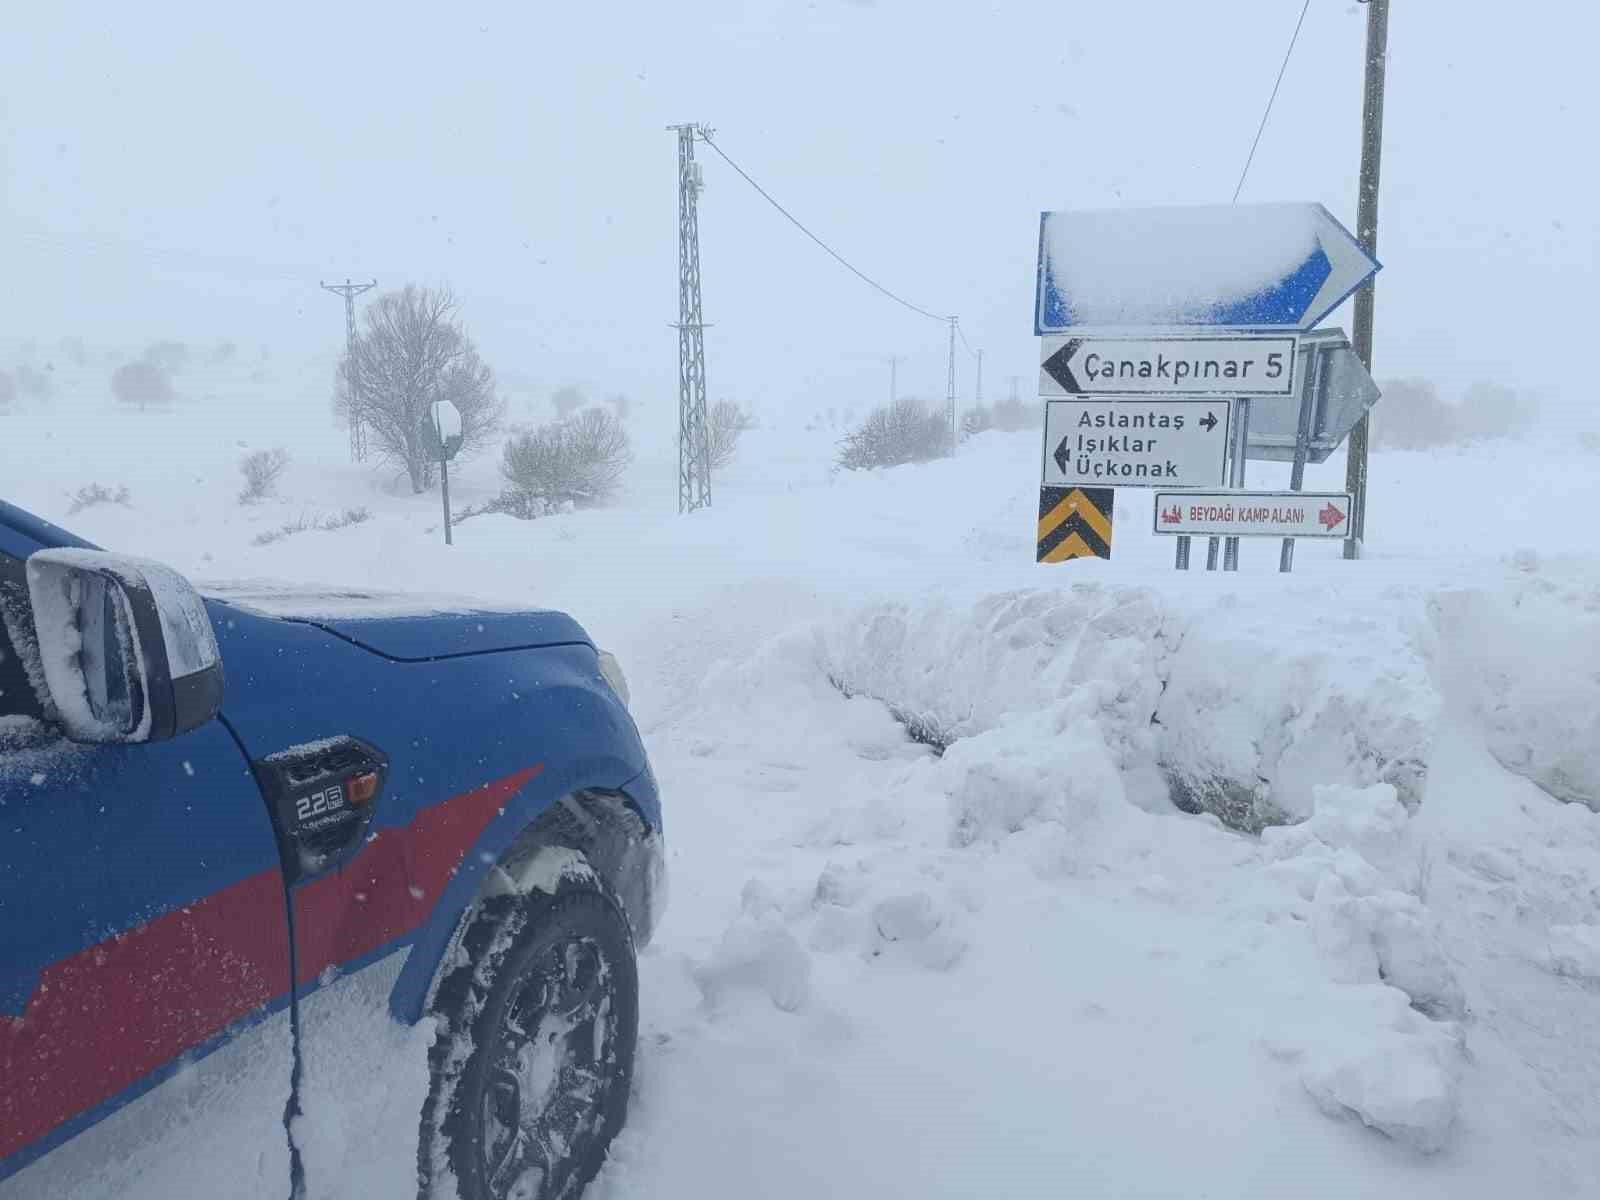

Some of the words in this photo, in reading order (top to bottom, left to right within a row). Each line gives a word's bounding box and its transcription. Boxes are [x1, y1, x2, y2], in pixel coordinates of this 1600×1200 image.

[1084, 353, 1254, 384] Çanakpınar
[1265, 353, 1283, 378] 5
[1078, 411, 1185, 430] Aslantaş
[1077, 435, 1157, 453] Işıklar
[1076, 455, 1178, 477] Üçkonak
[1190, 505, 1234, 522] BEYDAĞI
[1238, 508, 1269, 523] KAMP
